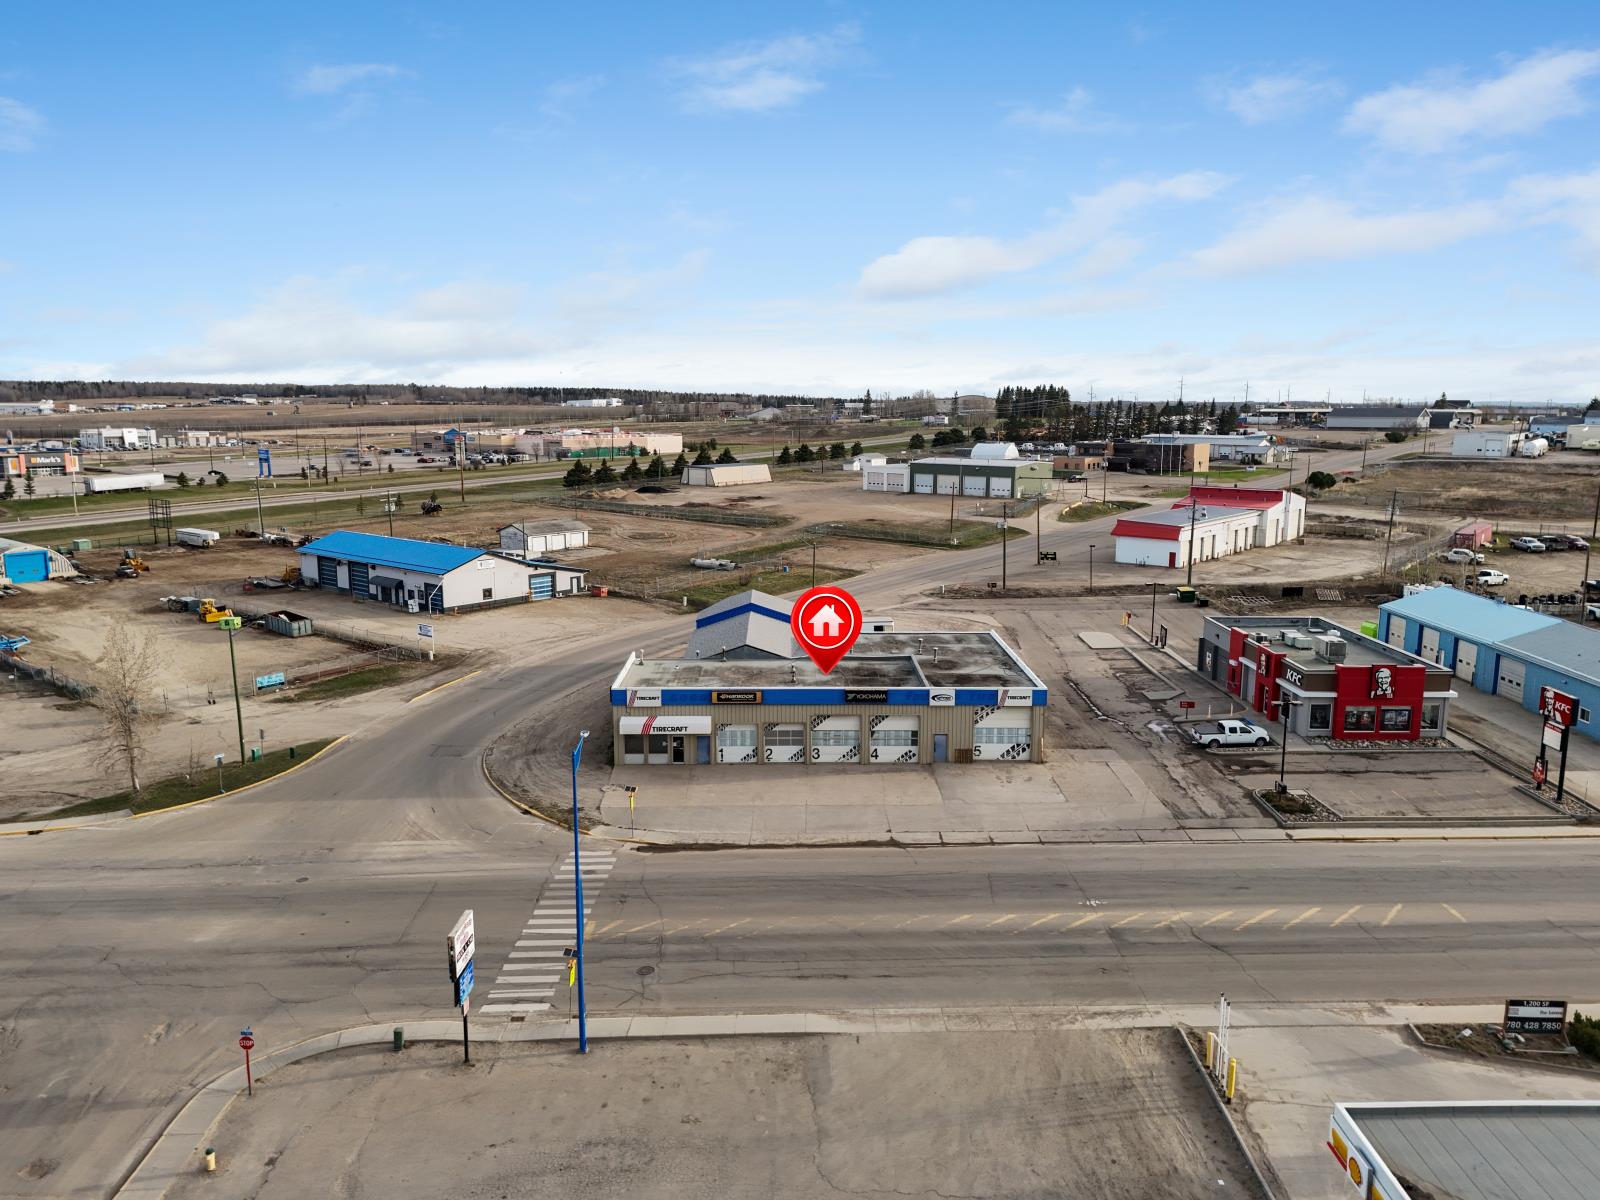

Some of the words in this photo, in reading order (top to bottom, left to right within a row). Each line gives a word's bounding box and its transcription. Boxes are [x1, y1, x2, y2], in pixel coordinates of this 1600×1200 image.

[1286, 668, 1302, 686] KFC
[1554, 701, 1572, 714] KFC
[718, 748, 724, 762] 1
[765, 748, 773, 761] 2
[811, 747, 821, 760] 3
[870, 748, 879, 760] 4
[973, 745, 982, 757] 5
[1524, 1021, 1539, 1029] 428
